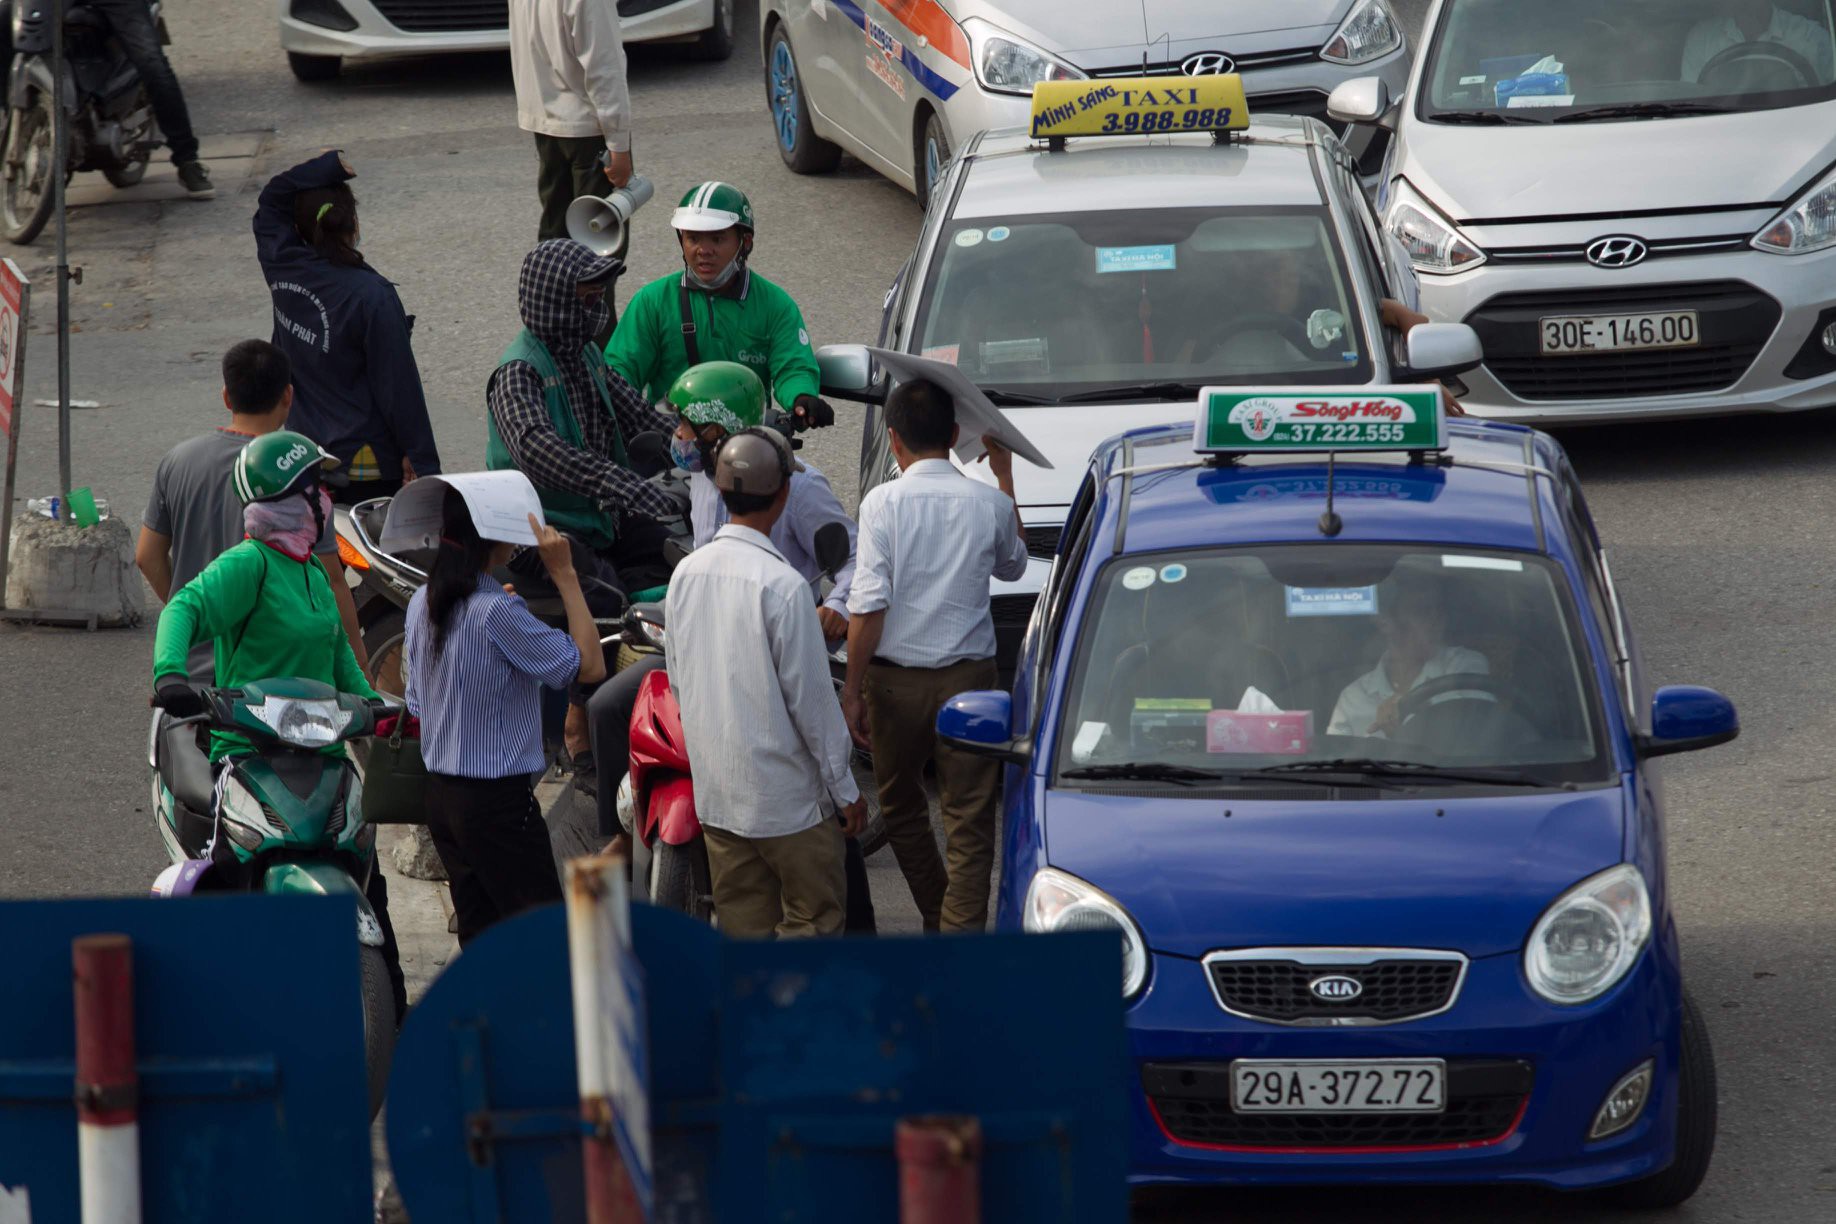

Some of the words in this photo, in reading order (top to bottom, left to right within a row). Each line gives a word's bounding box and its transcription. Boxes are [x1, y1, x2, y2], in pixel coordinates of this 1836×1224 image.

[1118, 88, 1200, 107] TAXI
[1102, 108, 1232, 132] 3.988.988
[1546, 315, 1694, 349] 30E-146.00
[738, 349, 767, 365] Grab
[1291, 424, 1404, 442] 37.222.555
[276, 443, 308, 470] Grab
[1301, 593, 1325, 601] TAXI
[1319, 982, 1354, 996] KIA
[1242, 1070, 1435, 1105] 29A-372.72
